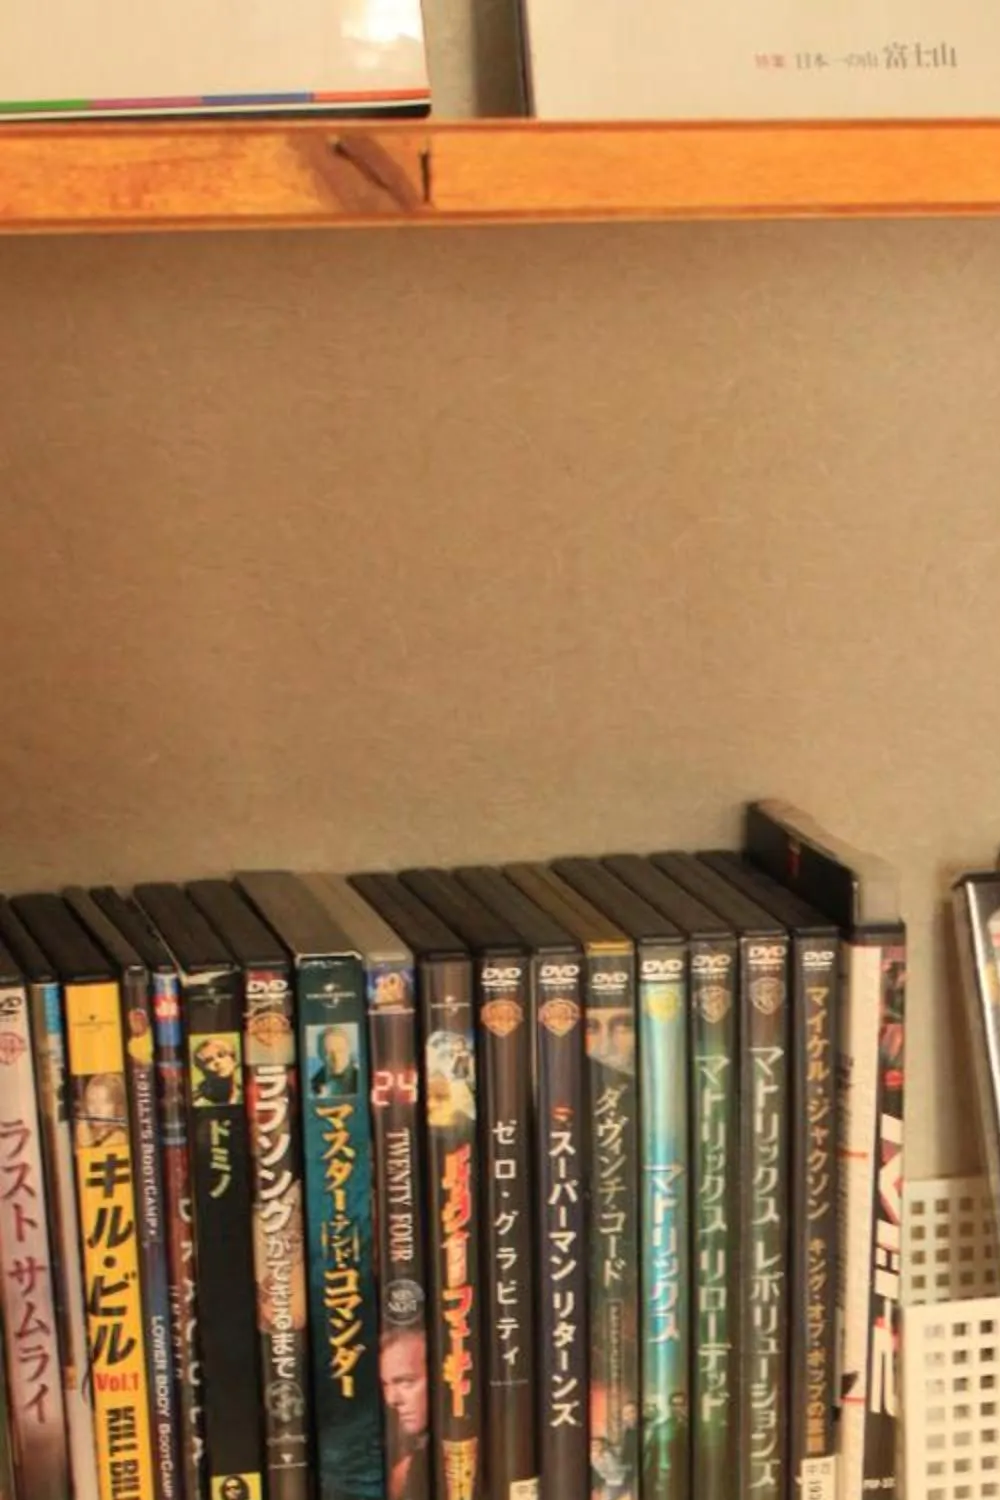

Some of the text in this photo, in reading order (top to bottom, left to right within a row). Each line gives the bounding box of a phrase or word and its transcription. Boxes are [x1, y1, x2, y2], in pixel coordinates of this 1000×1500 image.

[882, 41, 958, 70] 富士山
[641, 958, 684, 974] DVD
[372, 1069, 418, 1106] 24
[805, 987, 830, 1220] マイケル・ジャクソン
[209, 1117, 232, 1199] ドミノ
[385, 1126, 412, 1207] TWENTY
[595, 1083, 629, 1288] ダ・ヴィンチ・コード
[0, 1118, 50, 1424] ラスト サムライ
[86, 1152, 140, 1392] キル・ビル Vol.1
[389, 1212, 414, 1263] FOUR
[491, 1120, 520, 1365] ゼロ・グラビティ
[549, 1130, 580, 1427] スーパーマン リターンズ
[643, 1164, 686, 1343] マトリックス
[695, 1055, 732, 1422] マトリックス リローデッド
[748, 1046, 785, 1489] マトリックス レボリューションズ
[150, 1315, 171, 1370] LOWER
[156, 1374, 171, 1417] BODY
[105, 1405, 139, 1457] KILL
